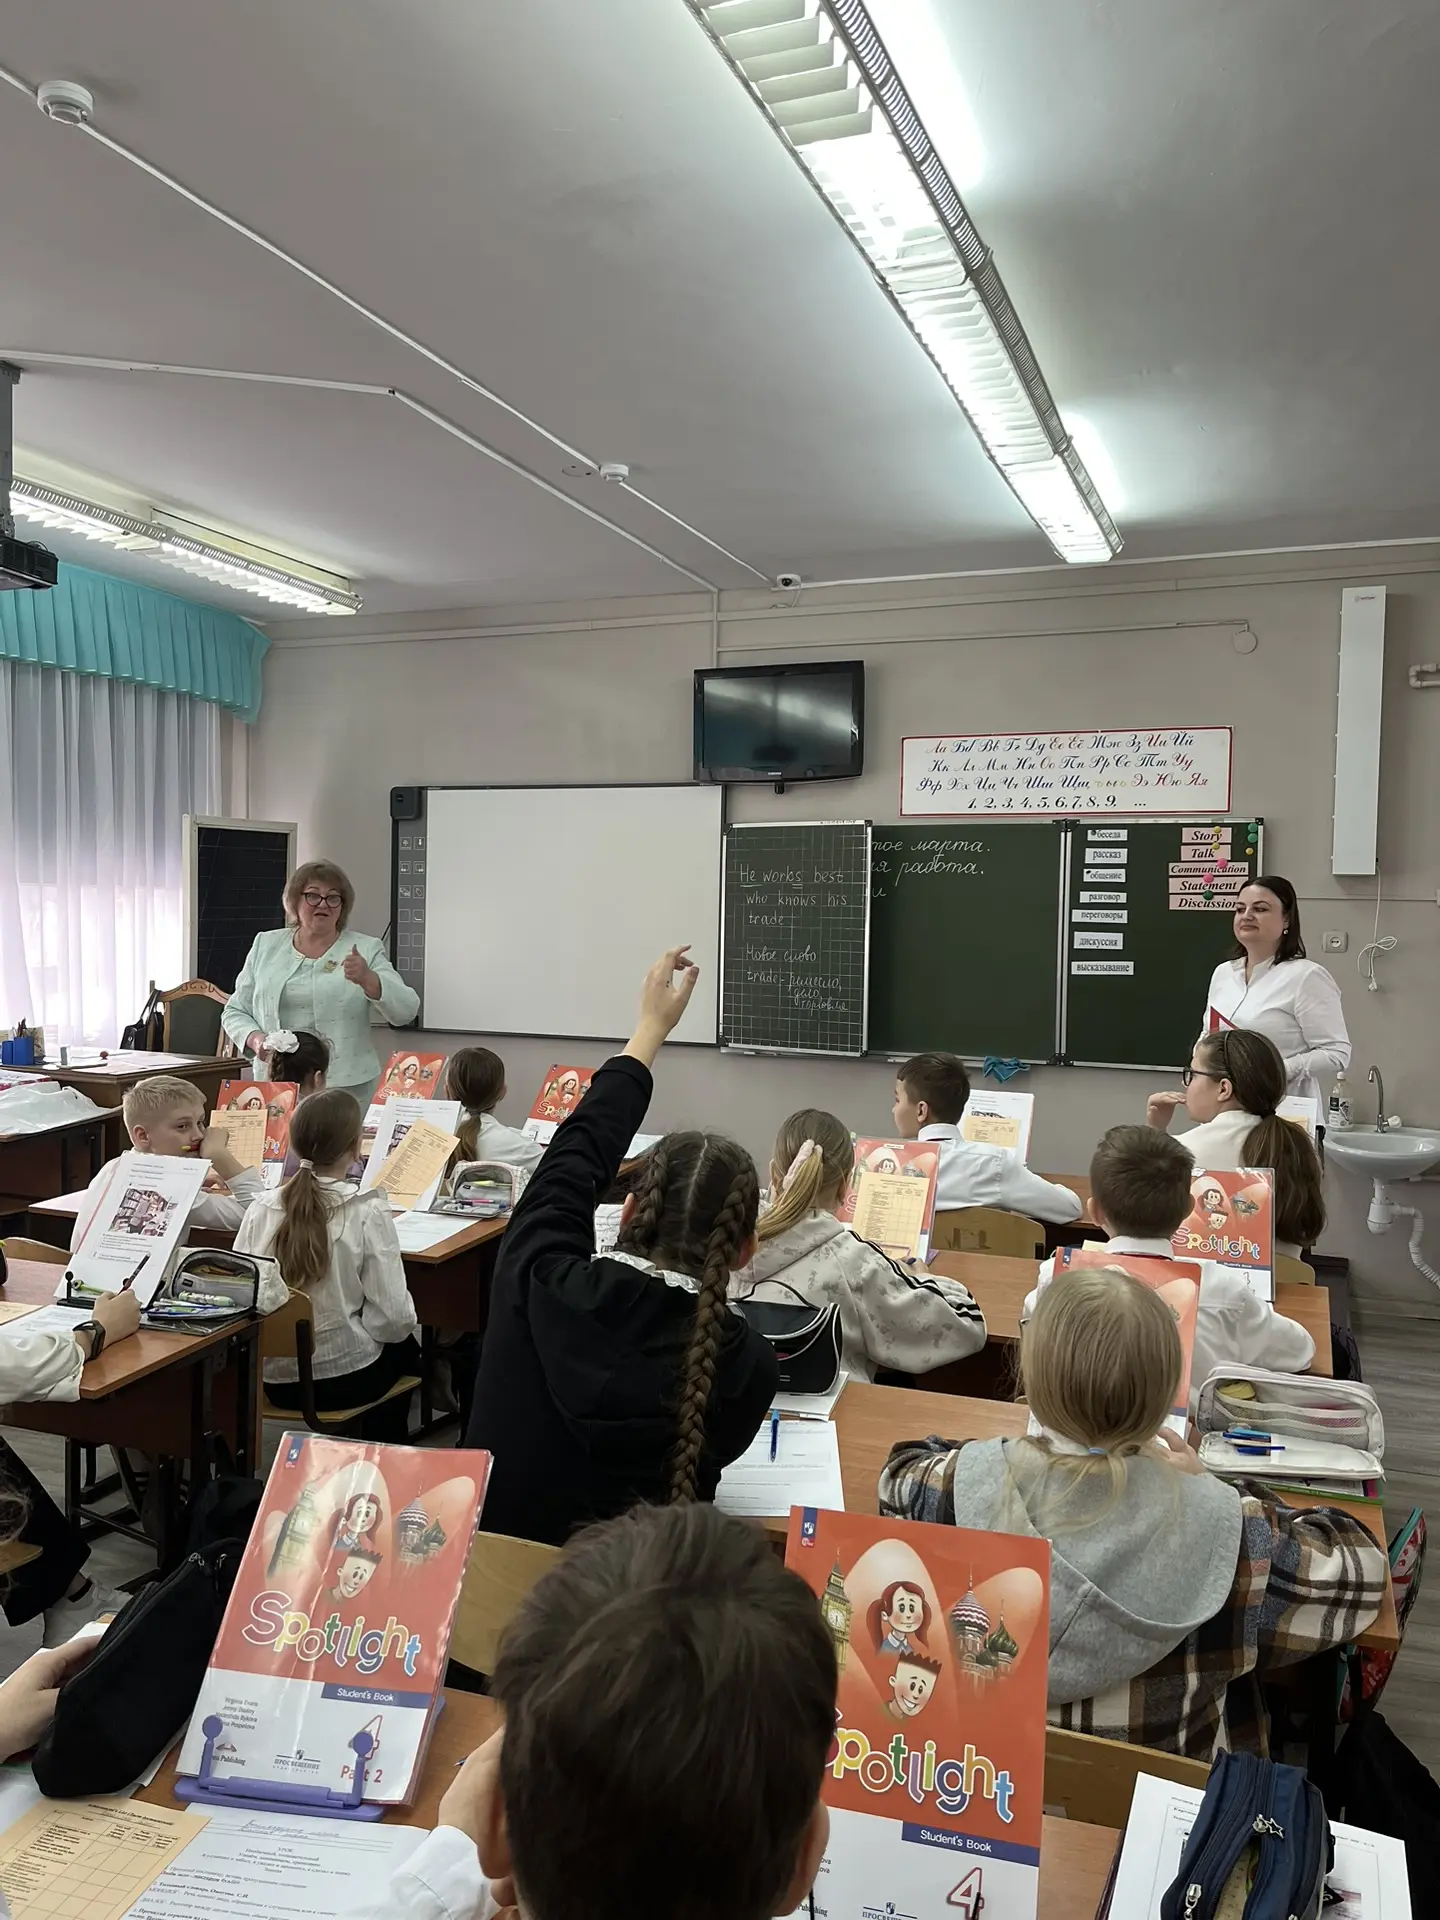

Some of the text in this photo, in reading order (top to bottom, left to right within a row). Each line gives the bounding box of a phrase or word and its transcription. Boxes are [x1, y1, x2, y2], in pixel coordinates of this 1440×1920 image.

[1191, 830, 1222, 842] Story
[911, 840, 992, 856] марта.
[1191, 848, 1215, 859] Talk
[1092, 850, 1121, 861] рассказ
[740, 863, 844, 883] He works best
[895, 853, 984, 887] работа.
[1090, 871, 1122, 881] общение
[1171, 864, 1246, 874] Communication
[1180, 880, 1237, 891] Statement
[745, 889, 848, 907] who knows his
[1088, 893, 1121, 903] разговор
[748, 909, 785, 926] trade
[1081, 910, 1123, 921] переговоры
[1079, 937, 1118, 949] дискуссия
[746, 942, 817, 962] Новое слово
[1076, 963, 1130, 973] высказывание
[1170, 1225, 1260, 1260] Spotlight
[242, 1590, 421, 1677] Spotlight
[337, 1687, 394, 1702] Student's Book
[340, 1765, 383, 1783] Pat 2
[920, 1829, 993, 1853] Student's Book
[946, 1867, 985, 1920] 4
[797, 1904, 828, 1918] ubhing
[862, 1911, 902, 1920] ПРОСВЕ
